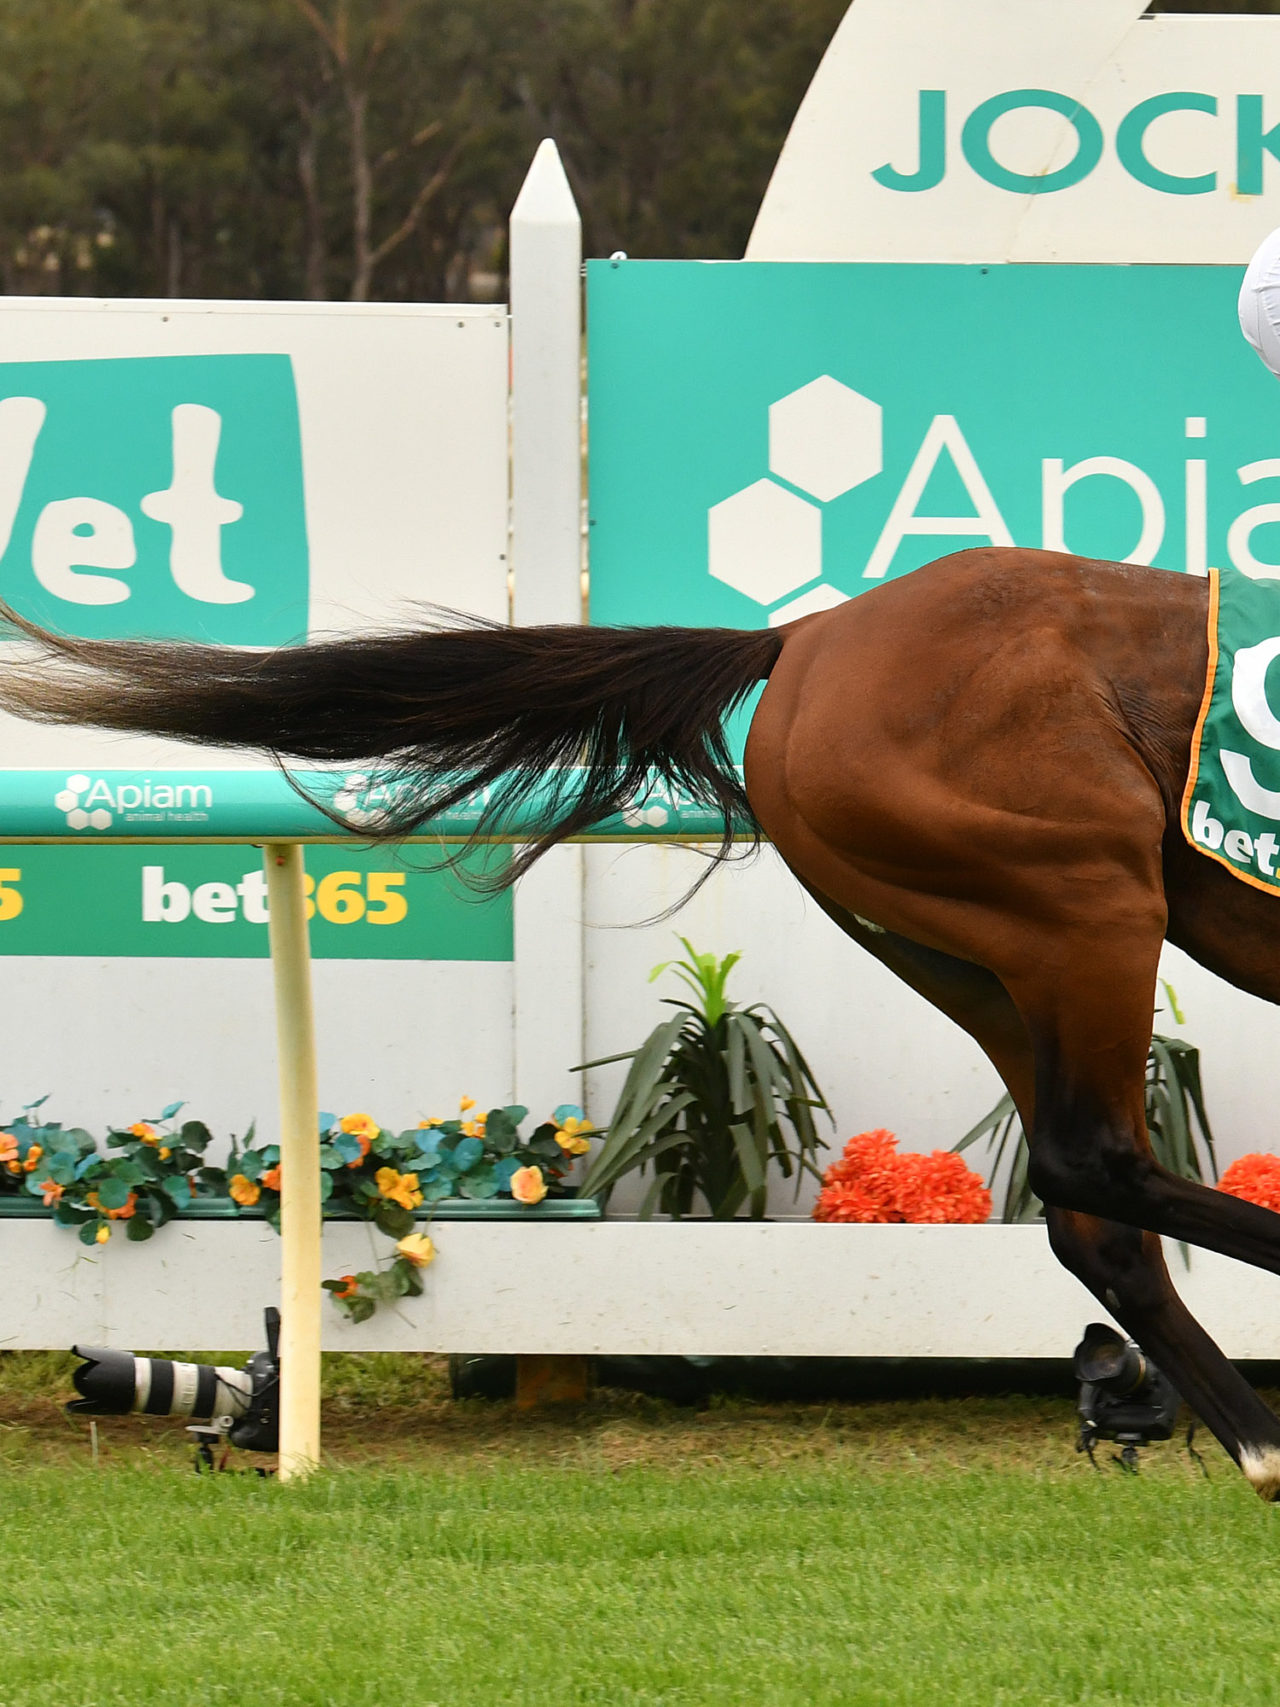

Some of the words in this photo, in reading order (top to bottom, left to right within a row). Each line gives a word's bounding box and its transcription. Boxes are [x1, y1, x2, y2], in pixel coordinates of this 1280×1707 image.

[84, 779, 213, 814] Apiam
[124, 811, 165, 821] animal
[167, 811, 209, 821] health
